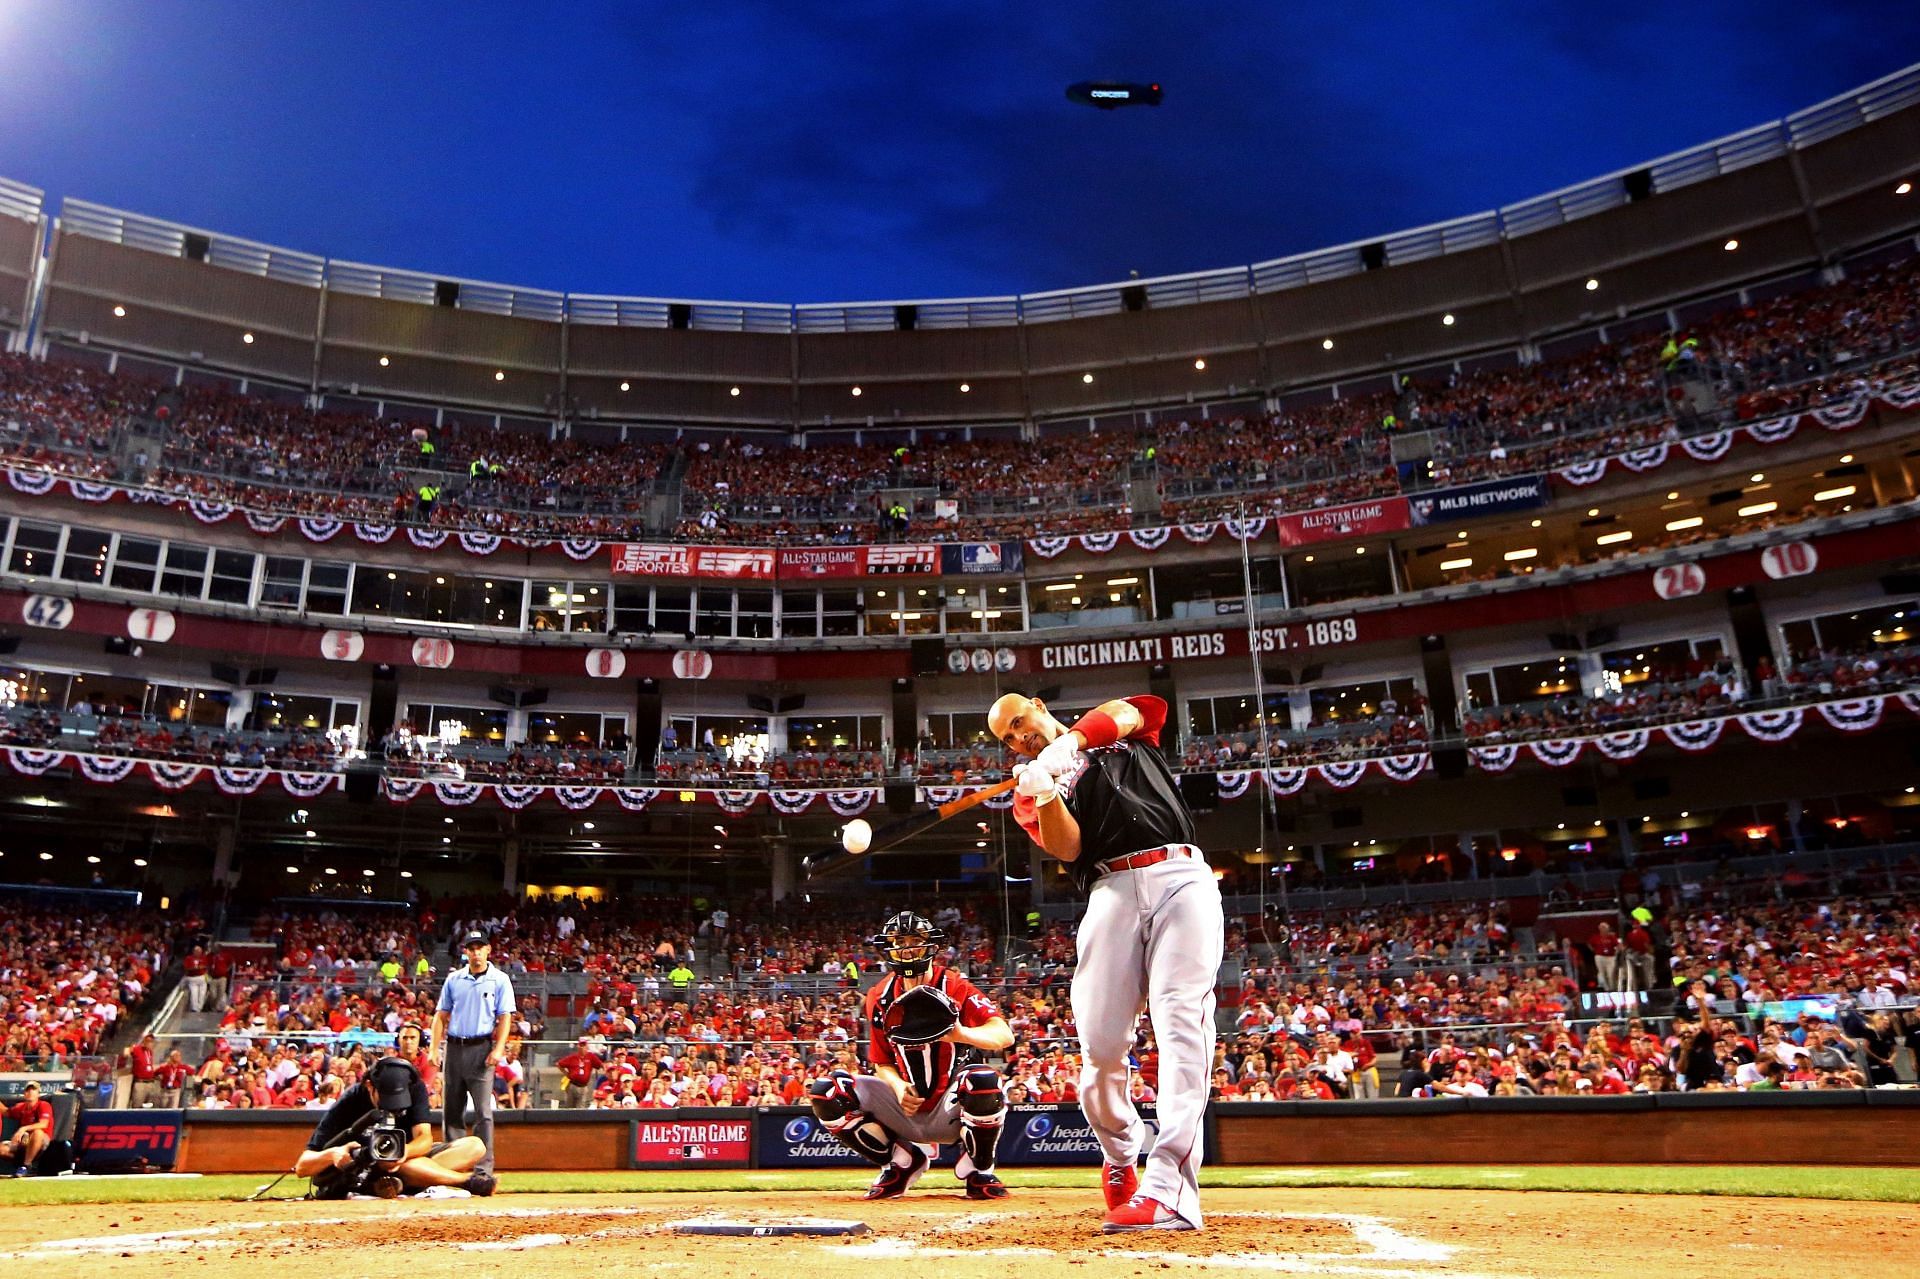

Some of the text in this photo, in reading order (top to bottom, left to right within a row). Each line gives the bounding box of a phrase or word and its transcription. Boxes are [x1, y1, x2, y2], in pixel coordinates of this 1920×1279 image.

[1440, 485, 1538, 510] MLB NETWORK
[1352, 505, 1382, 520] GAME
[624, 544, 687, 562] ESPN
[698, 551, 773, 573] ESPN
[828, 551, 856, 564] GAME
[867, 546, 935, 565] ESPN
[1769, 543, 1809, 576] 10
[616, 560, 690, 574] DEPORTES
[868, 565, 932, 574] RADIO
[1661, 563, 1700, 597] 24
[28, 596, 66, 626] 42
[145, 610, 157, 640] 1
[335, 630, 352, 659] 5
[418, 638, 450, 666] 20
[1042, 618, 1357, 668] CINCINNATI REDS EST. 1869
[599, 650, 611, 676] 8
[81, 1125, 177, 1149] ESPN
[708, 1124, 747, 1142] GAME
[1052, 1125, 1091, 1138] head
[788, 1143, 859, 1157] shoulders
[1031, 1139, 1100, 1153] shoulders
